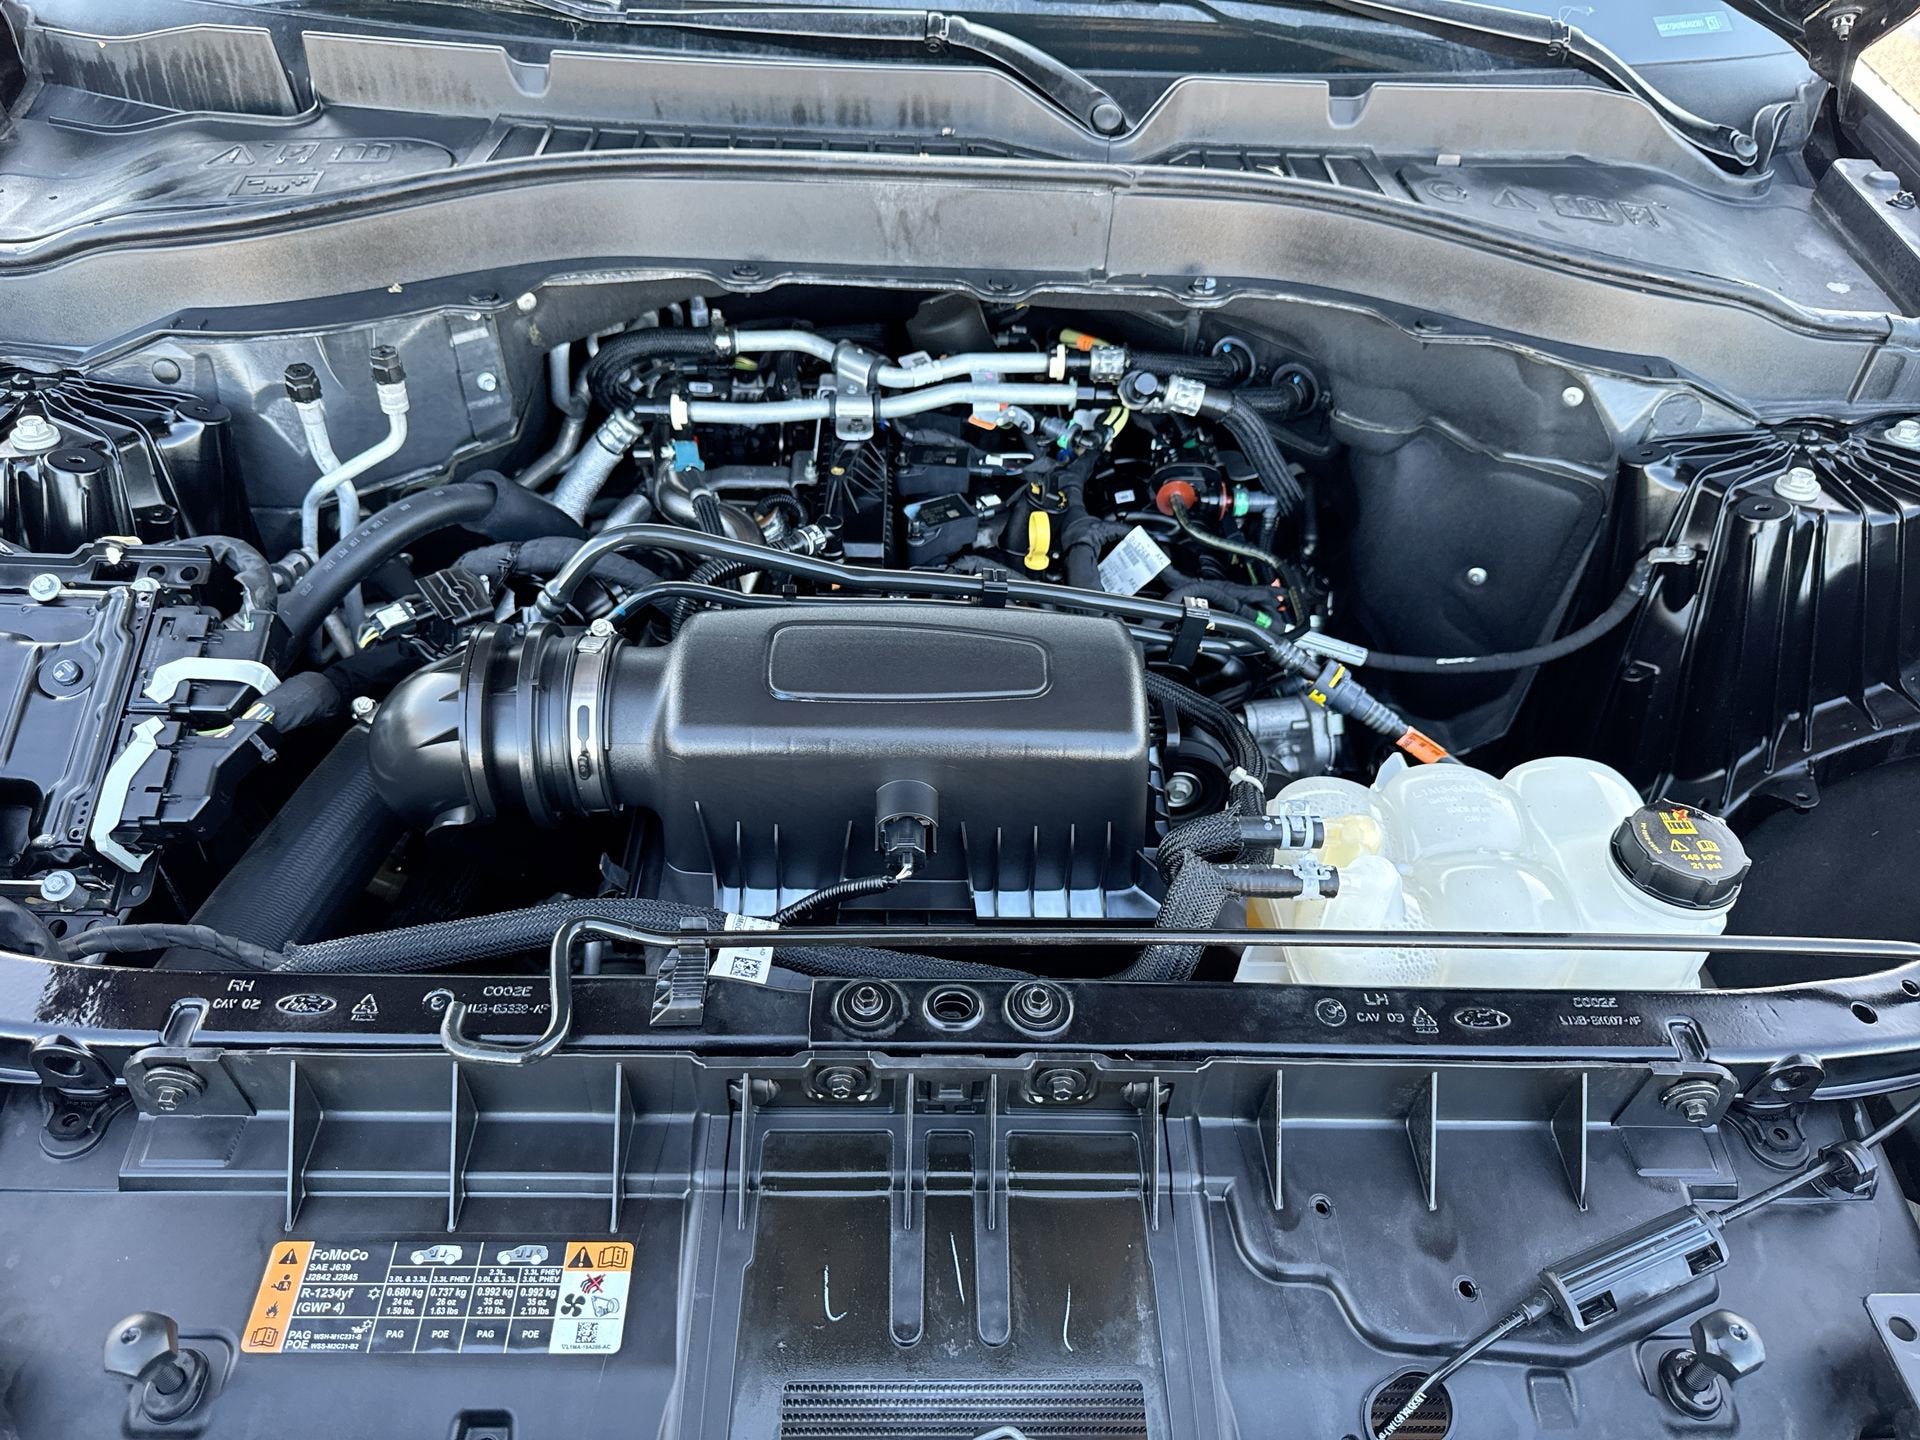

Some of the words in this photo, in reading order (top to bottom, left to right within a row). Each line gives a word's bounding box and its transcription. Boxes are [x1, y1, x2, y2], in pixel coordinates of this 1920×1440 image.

[227, 979, 255, 992] RH
[1363, 993, 1389, 1006] LH
[1356, 1012, 1380, 1023] CAV
[311, 1249, 369, 1261] FoMoCo
[308, 1263, 328, 1271] SAE
[329, 1263, 352, 1271] J639
[524, 1268, 540, 1276] 3.3L
[540, 1268, 562, 1276] FHEV
[305, 1273, 331, 1281] J2842
[332, 1273, 358, 1281] J2845
[389, 1275, 404, 1283] 3.0L
[405, 1275, 412, 1283] &
[412, 1275, 428, 1283] 3.3L
[432, 1275, 449, 1283] 3.3L
[449, 1275, 471, 1283] FHEV
[477, 1275, 493, 1283] 3.0L
[493, 1275, 500, 1283] &
[500, 1275, 516, 1283] 3.3L
[522, 1275, 538, 1283] 3.0L
[539, 1275, 561, 1283] PHEV
[301, 1287, 355, 1300] R-1234yf
[386, 1287, 411, 1297] 0.680
[411, 1288, 424, 1299] kg
[430, 1287, 455, 1297] 0.737
[455, 1288, 468, 1299] kg
[477, 1287, 502, 1297] 0.992
[501, 1287, 514, 1299] kg
[520, 1287, 545, 1297] 0.992
[545, 1287, 558, 1299] kg
[391, 1297, 404, 1306] 24
[435, 1297, 447, 1306] 26
[483, 1297, 494, 1306] 35
[526, 1297, 537, 1306] 35
[296, 1301, 332, 1315] (GWP
[332, 1301, 345, 1315] 4)
[386, 1306, 403, 1315] 1.50
[402, 1306, 415, 1315] lbs
[430, 1306, 447, 1315] 1.63
[446, 1306, 459, 1315] lbs
[476, 1306, 494, 1315] 2.19
[493, 1306, 506, 1315] lbs
[520, 1306, 537, 1315] 2.19
[536, 1306, 550, 1315] lbs
[288, 1330, 312, 1340] PAG
[385, 1329, 405, 1339] PAG
[431, 1329, 450, 1339] POE
[476, 1329, 495, 1339] PAG
[521, 1329, 540, 1339] POE
[284, 1339, 309, 1350] POE
